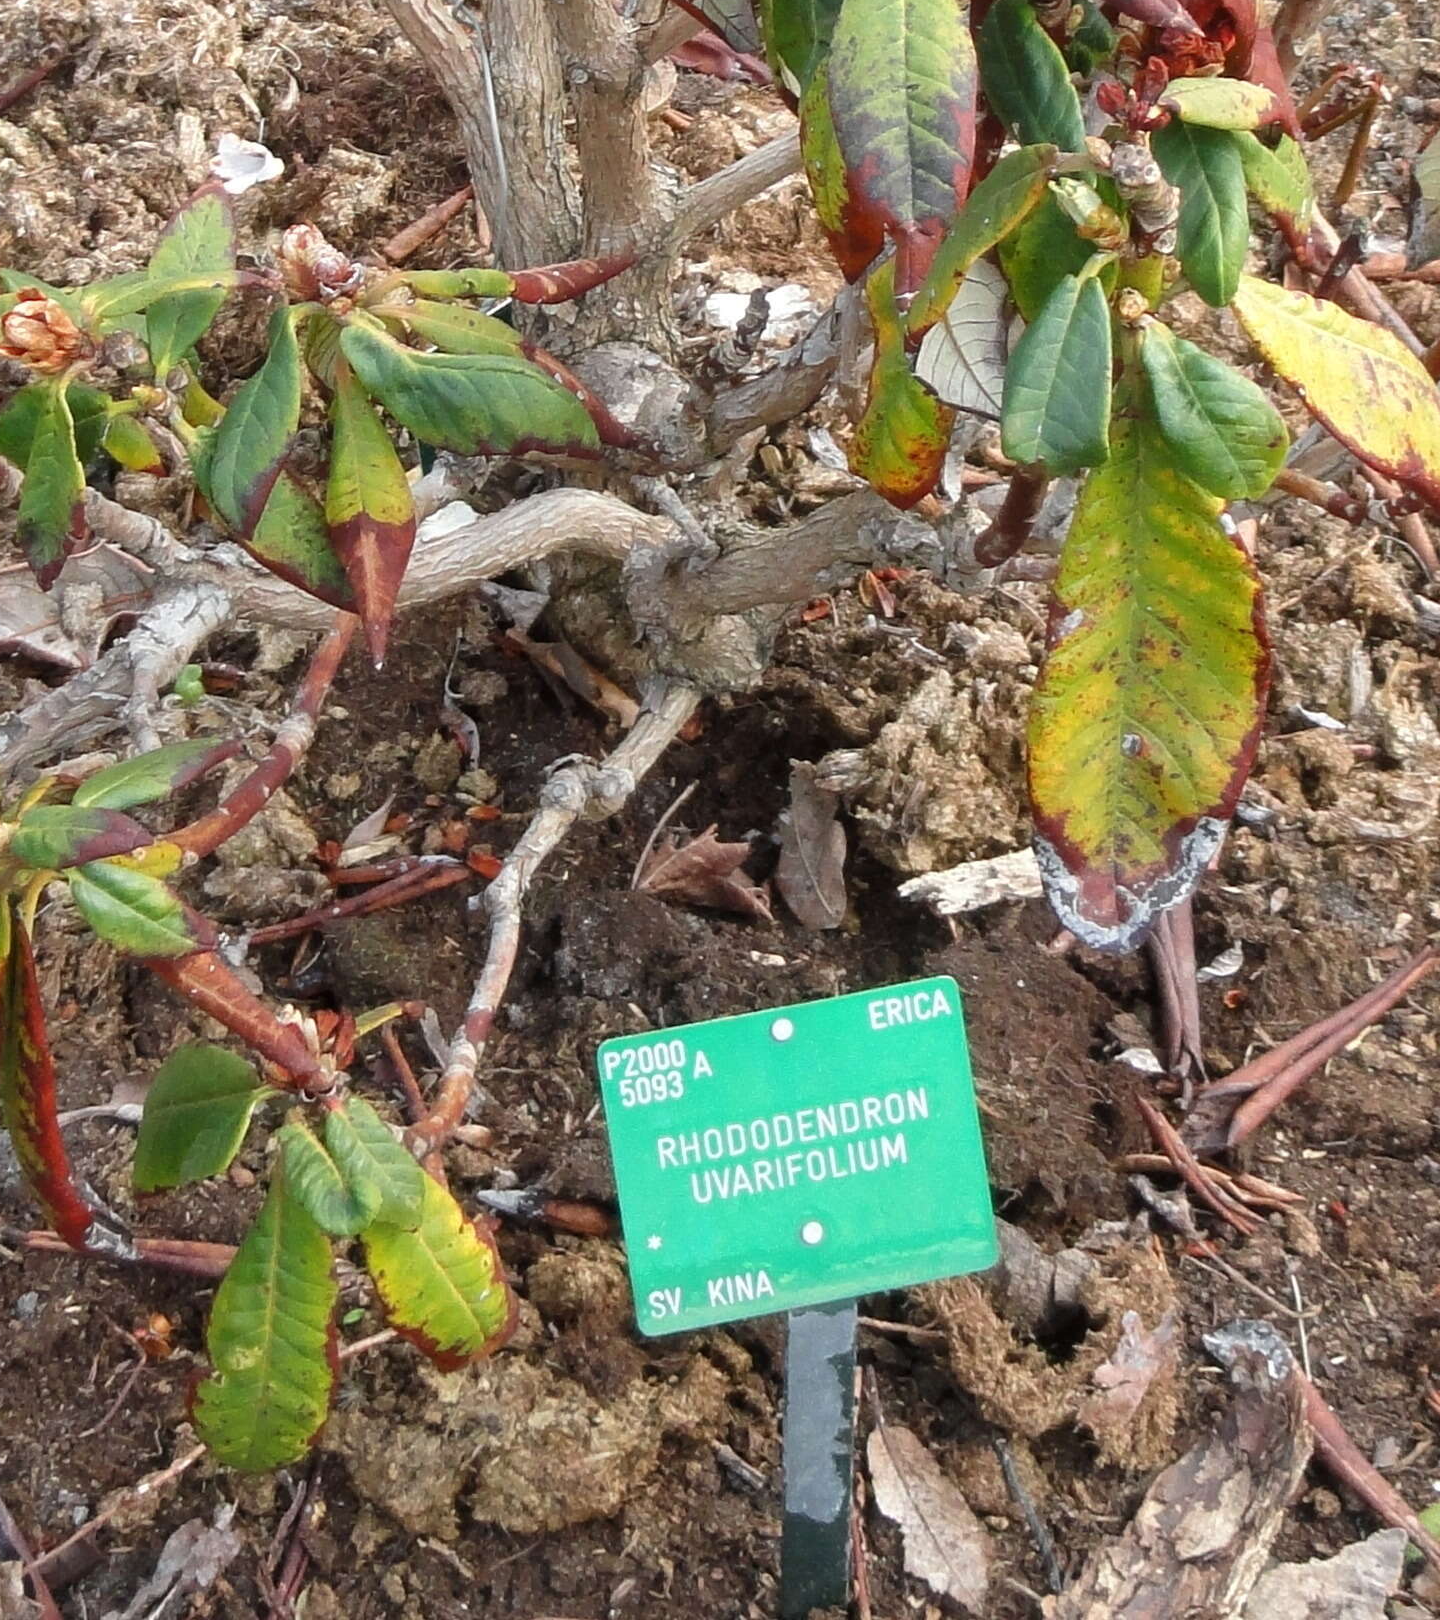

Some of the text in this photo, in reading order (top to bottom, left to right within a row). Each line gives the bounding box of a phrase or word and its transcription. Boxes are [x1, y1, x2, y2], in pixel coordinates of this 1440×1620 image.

[869, 990, 951, 1029] ERICA
[604, 1040, 712, 1079] P2000 A
[619, 1072, 683, 1107] 5093
[658, 1088, 928, 1168] RHODODENDRON
[692, 1133, 907, 1203] UVARIFOLIUM
[649, 1271, 775, 1319] SV KINA
